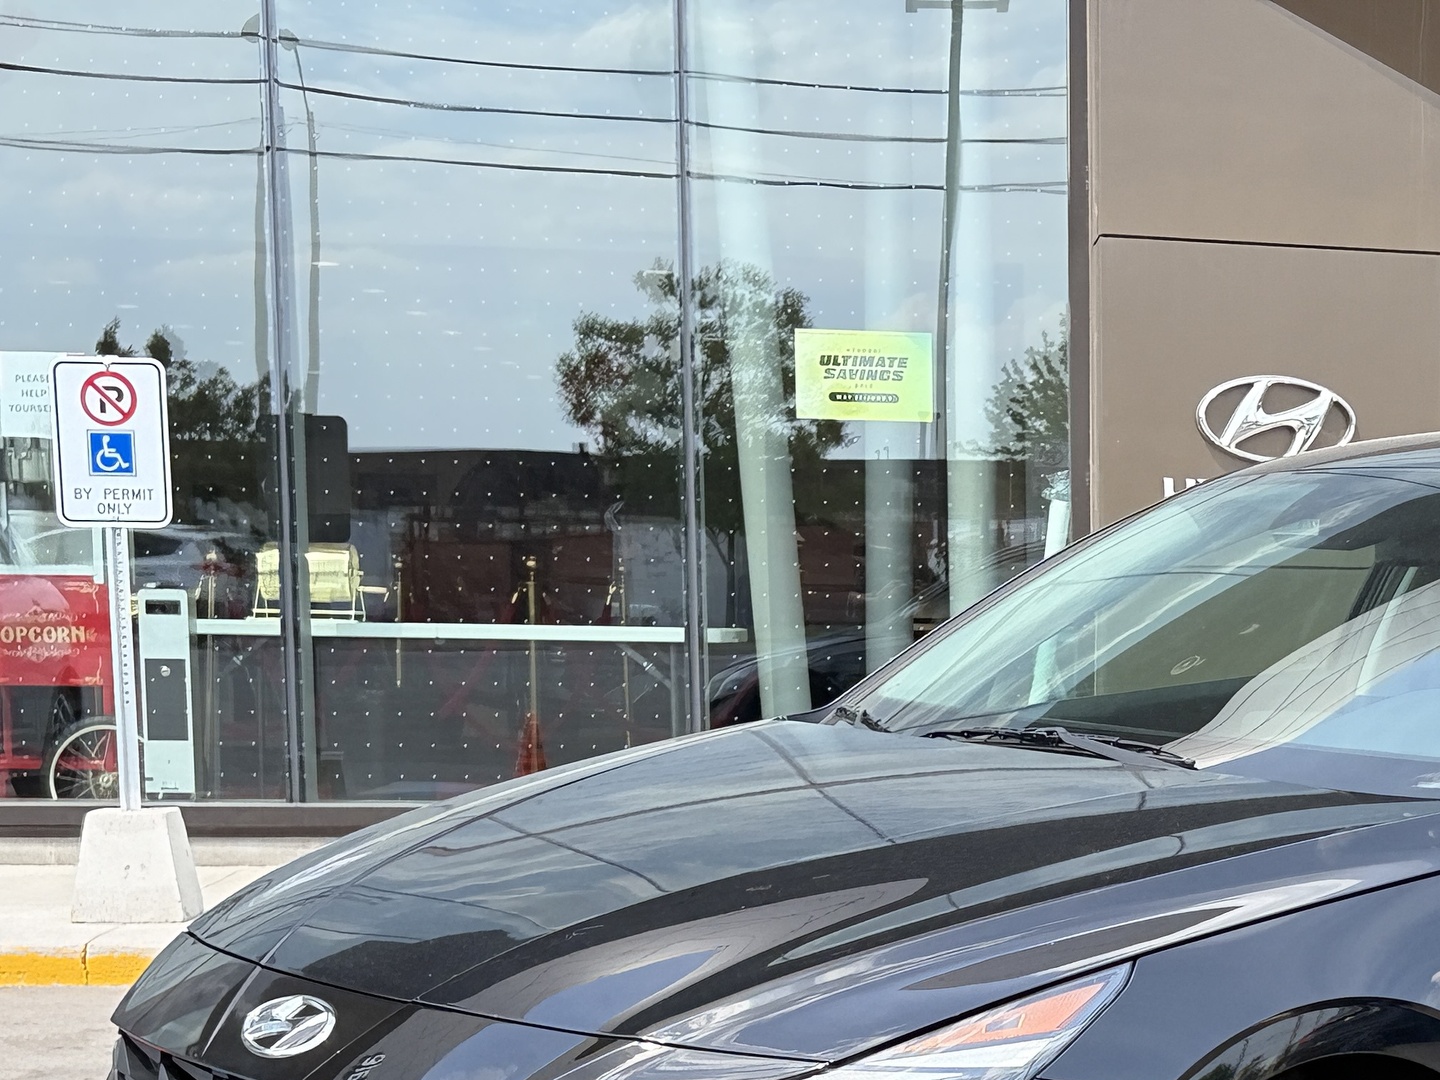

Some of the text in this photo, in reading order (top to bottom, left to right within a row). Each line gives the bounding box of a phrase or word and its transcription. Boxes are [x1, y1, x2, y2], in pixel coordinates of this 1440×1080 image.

[819, 354, 908, 368] ULTIMATE
[823, 368, 904, 381] SAVINGS
[21, 390, 47, 398] HELP
[9, 404, 51, 413] YOURSE
[74, 488, 154, 500] BY PERMIT
[97, 503, 132, 515] ONLY
[0, 625, 86, 643] OPCORN
